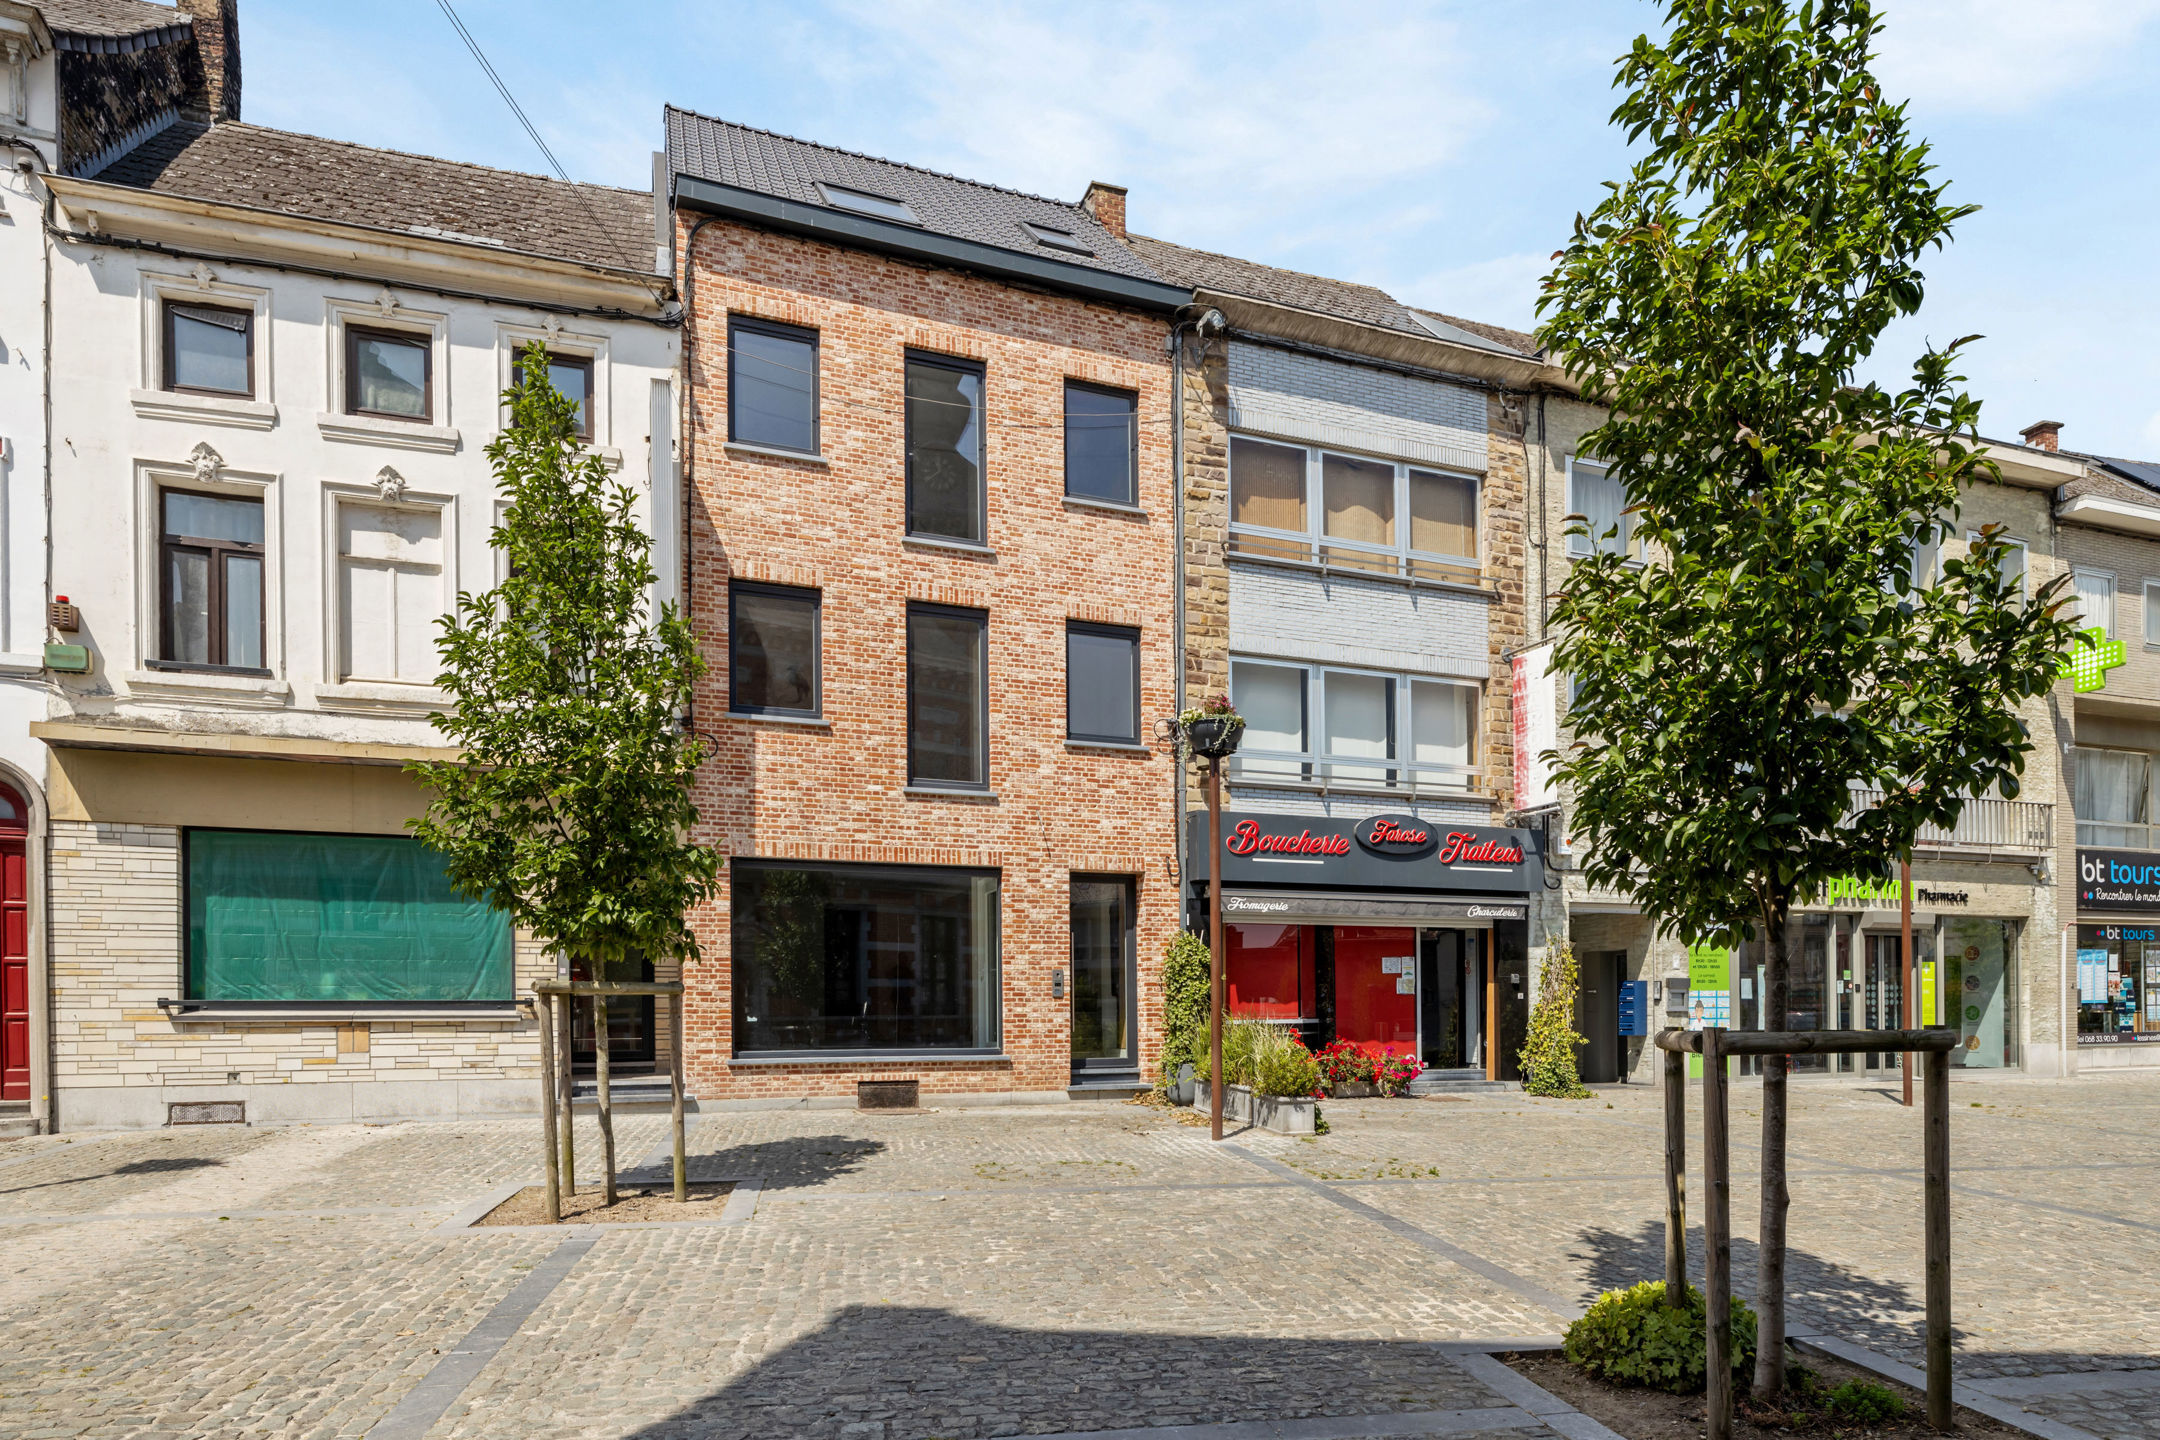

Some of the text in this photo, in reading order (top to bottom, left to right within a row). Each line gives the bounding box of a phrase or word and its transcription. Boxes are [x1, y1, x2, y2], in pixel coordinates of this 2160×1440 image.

[1226, 820, 1350, 854] Boucherie
[1439, 832, 1524, 863] Traiteur
[2081, 854, 2160, 885] bt tours
[1918, 888, 1968, 902] Pharmacie
[1227, 897, 1289, 912] Fromagerie
[1467, 905, 1518, 917] Charcuterie
[2107, 925, 2155, 941] bt tours
